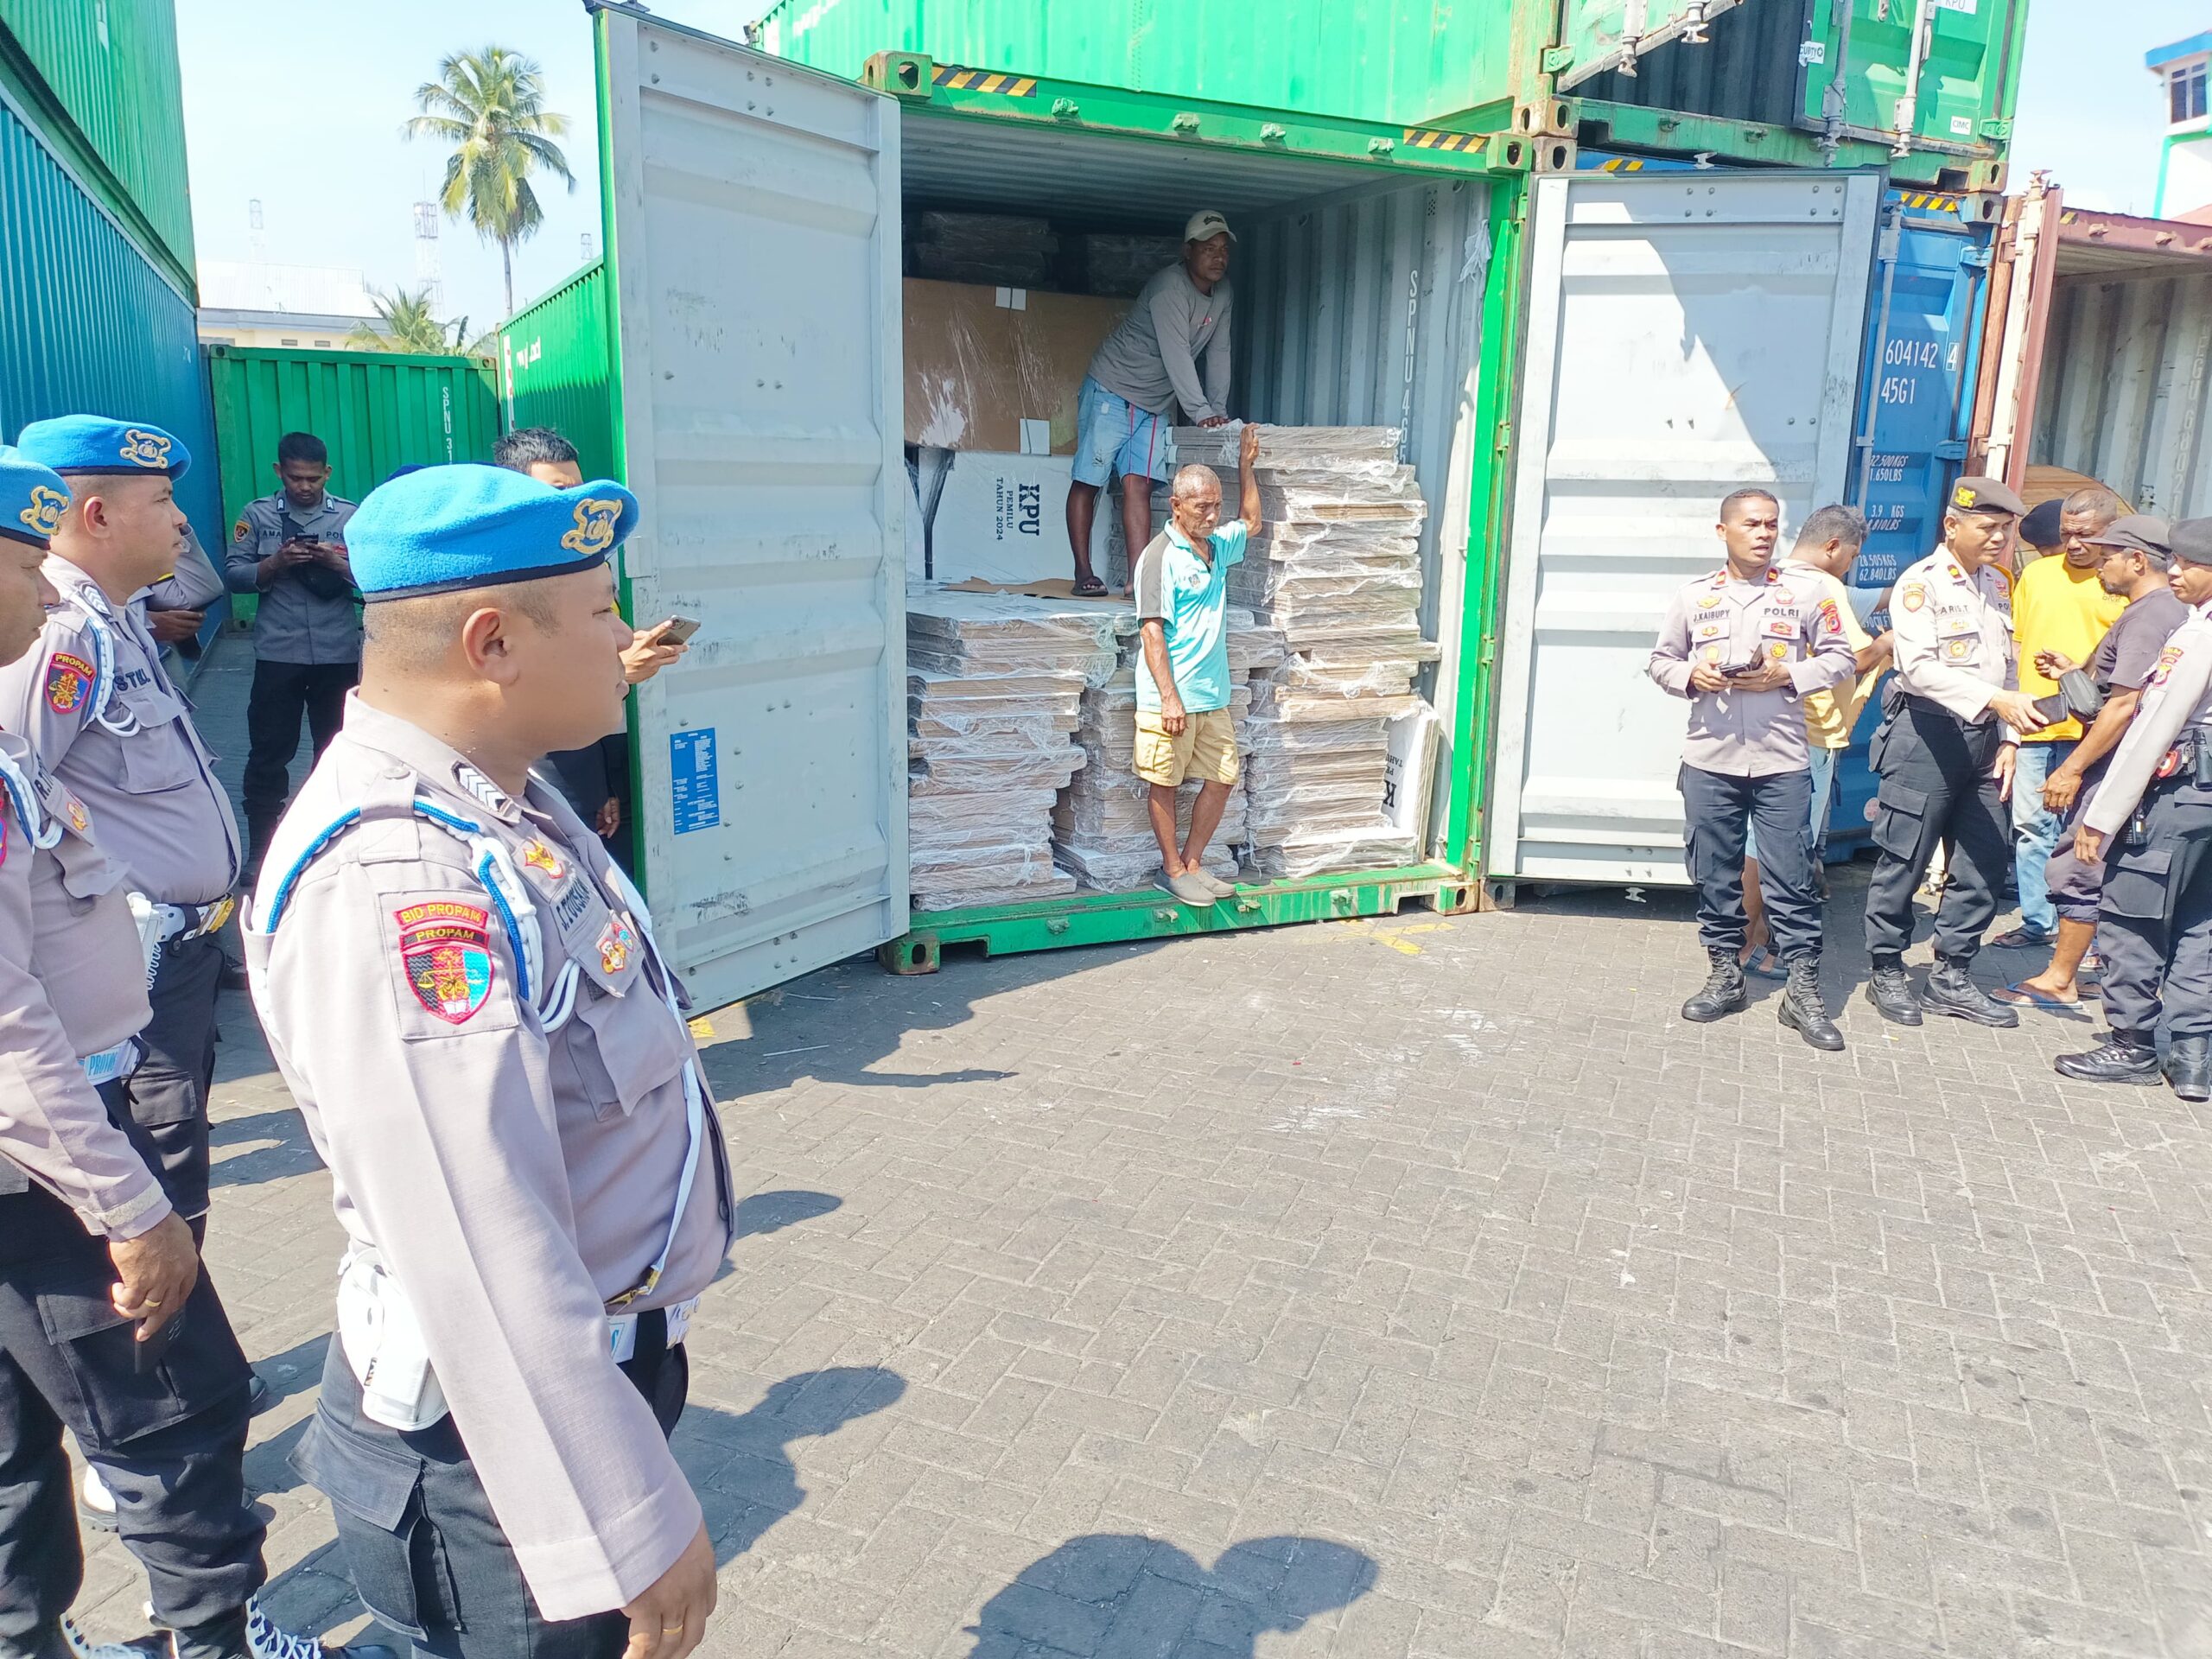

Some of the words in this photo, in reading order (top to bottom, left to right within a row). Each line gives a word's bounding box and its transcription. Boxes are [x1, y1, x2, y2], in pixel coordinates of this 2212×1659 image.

[1404, 270, 1418, 383] SPNU
[1885, 339, 1939, 369] 604142
[1947, 344, 1959, 371] 4
[1881, 377, 1916, 404] 45G1
[442, 386, 452, 434] SPNU
[995, 477, 1004, 512] TAHUN
[1019, 483, 1040, 536] KPU
[1891, 505, 1905, 518] KGS
[995, 516, 1004, 541] 2024
[1764, 607, 1800, 618] POLRI
[54, 654, 93, 677] PROPAM
[400, 907, 424, 924] BID
[427, 904, 482, 923] PROPAM
[416, 929, 475, 942] PROPAM
